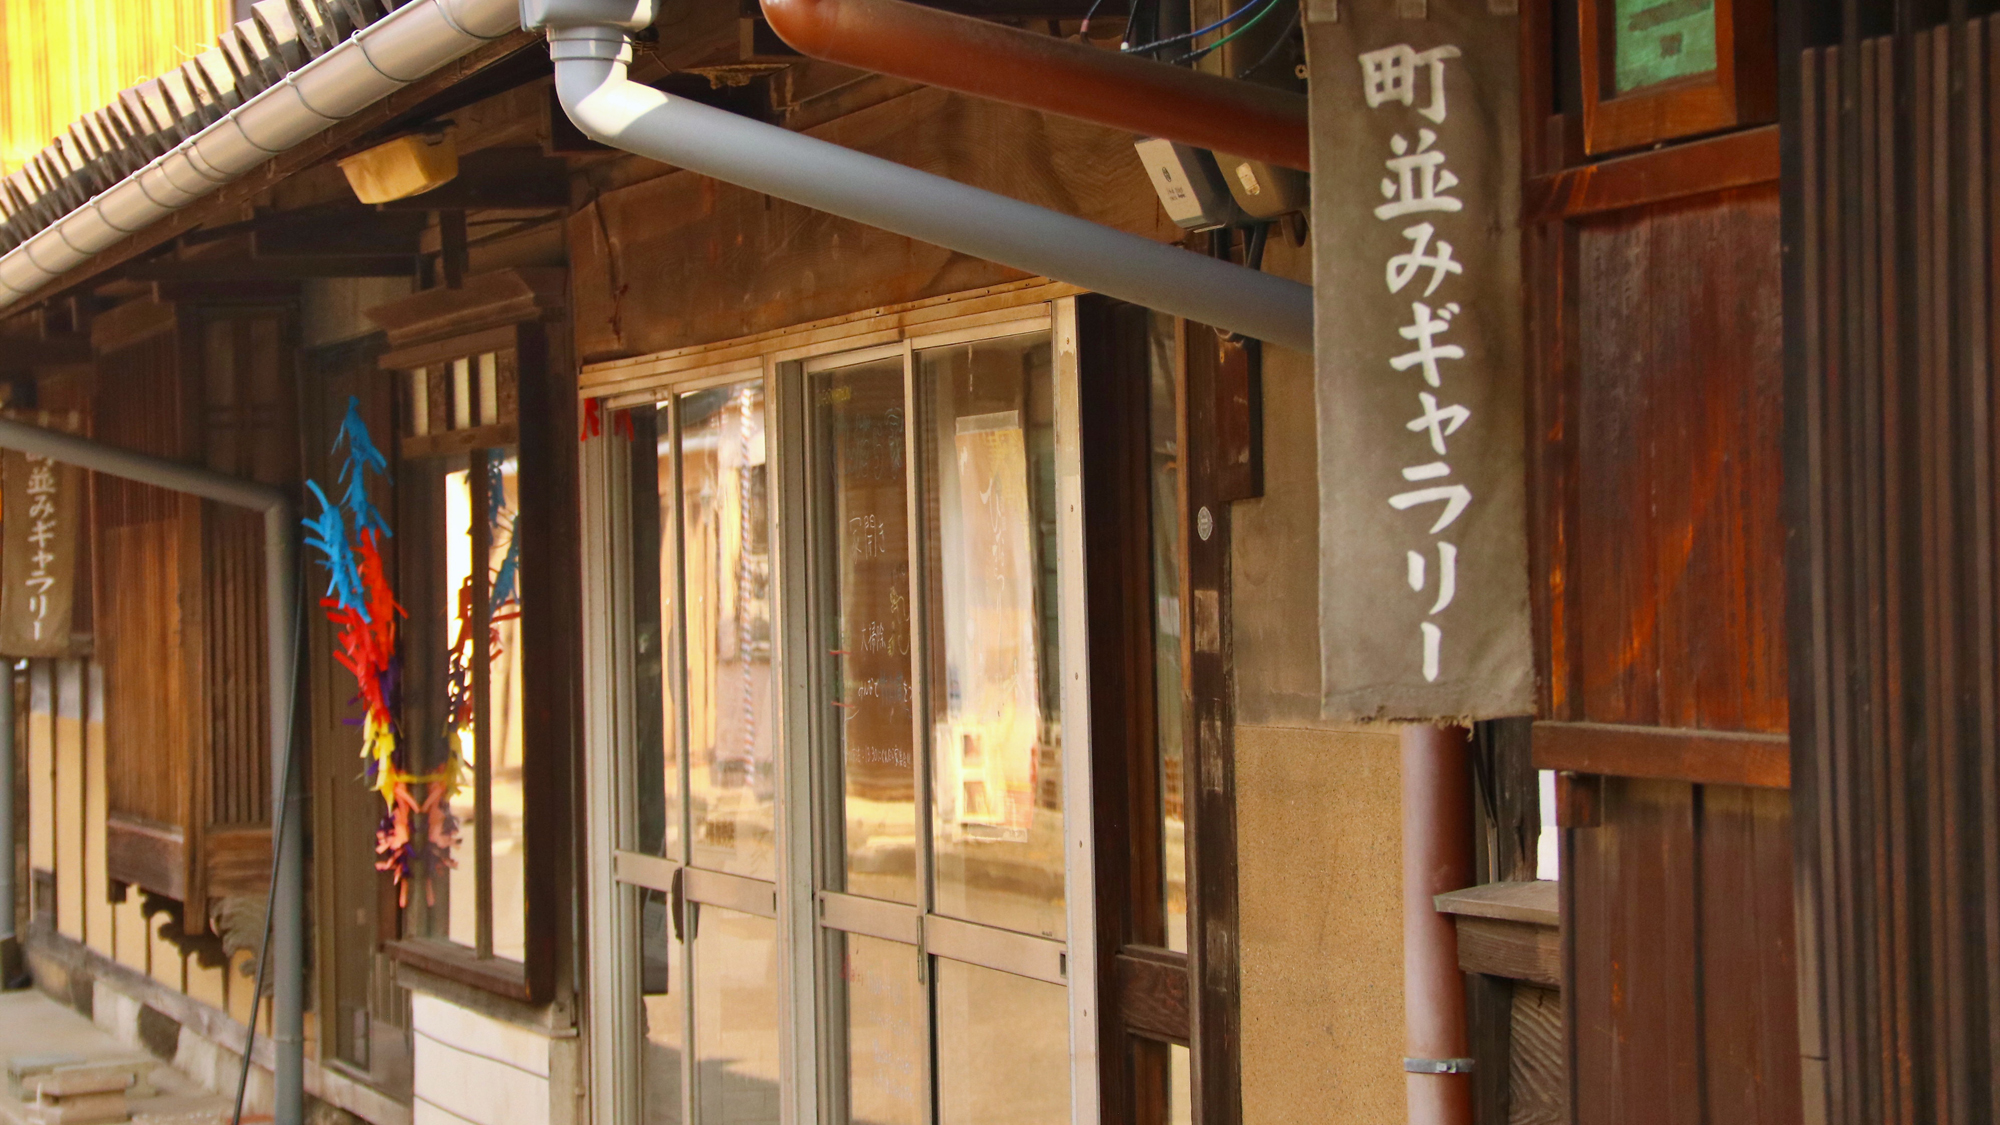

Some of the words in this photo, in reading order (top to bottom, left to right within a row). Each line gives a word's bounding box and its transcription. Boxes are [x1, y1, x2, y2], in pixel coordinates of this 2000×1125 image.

[26, 451, 56, 640] 並みギャラリー
[1358, 43, 1472, 682] 町並みギャラリー
